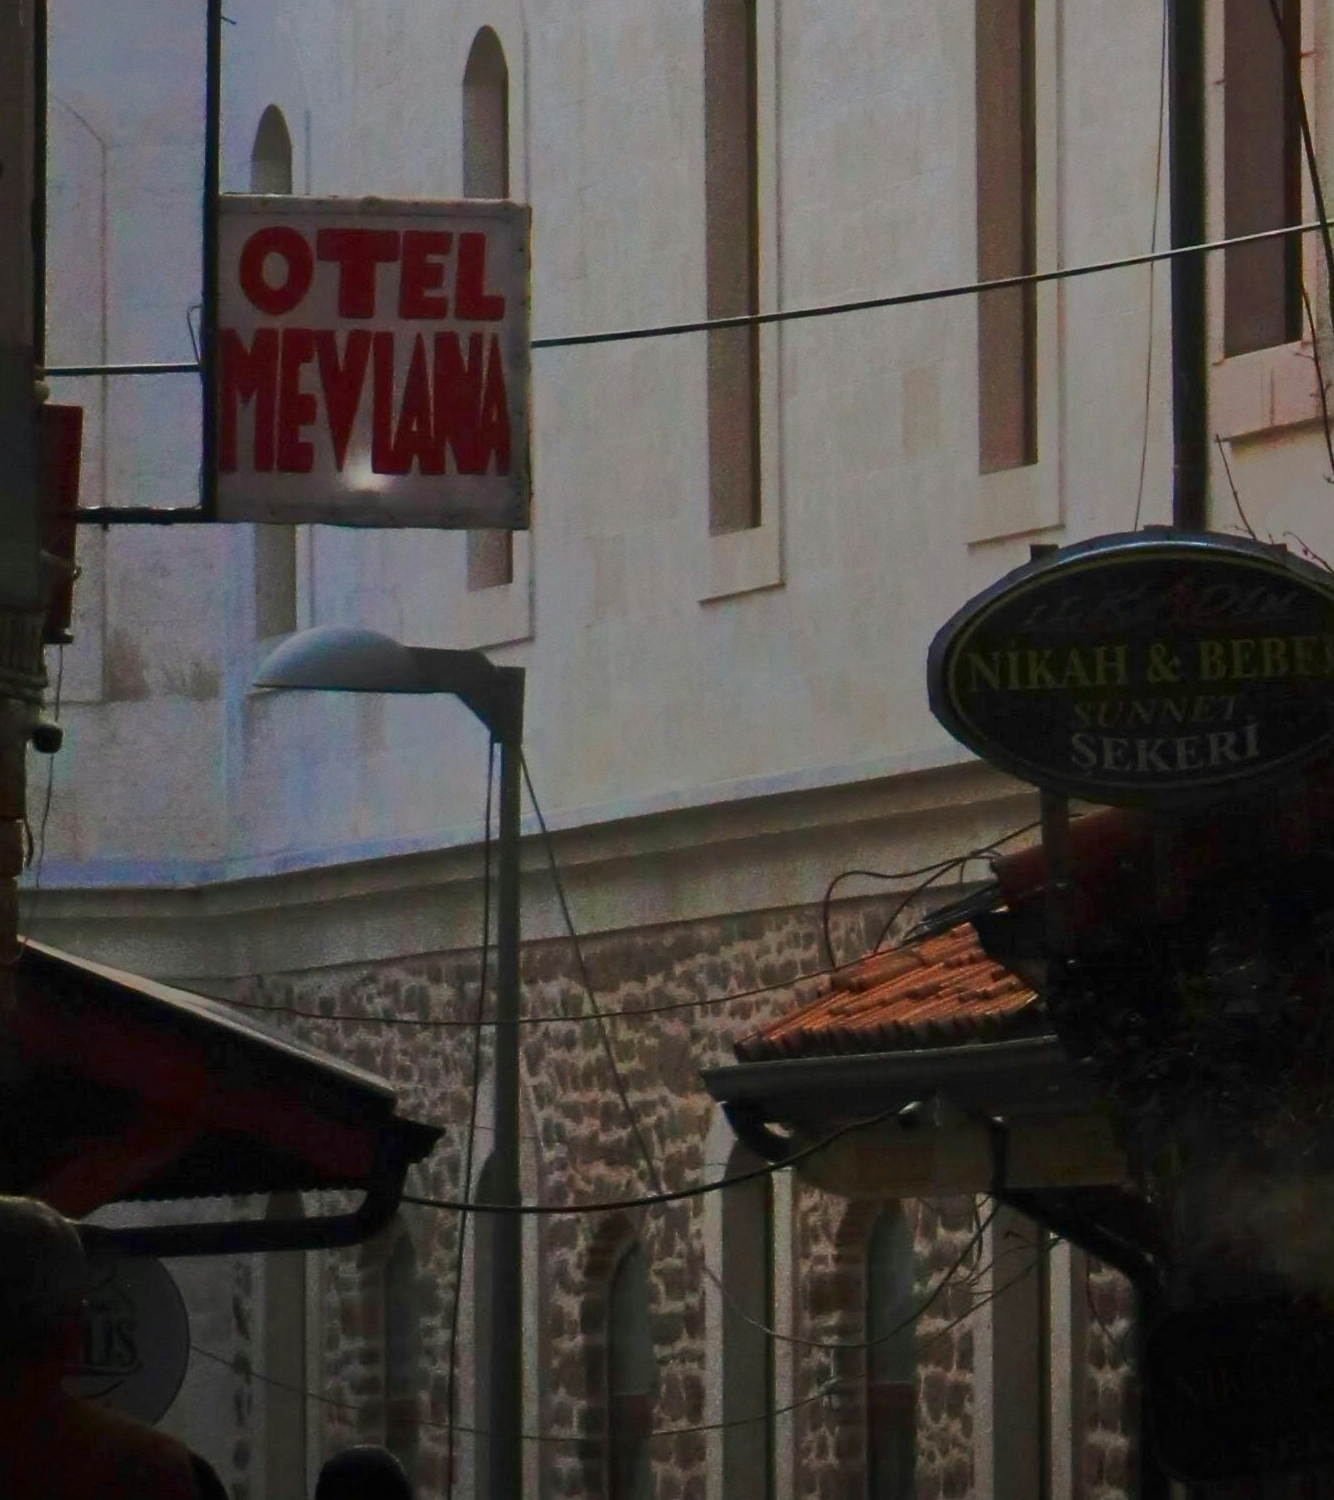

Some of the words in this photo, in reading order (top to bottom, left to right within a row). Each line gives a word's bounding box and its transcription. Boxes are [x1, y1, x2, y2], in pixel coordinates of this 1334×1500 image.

[238, 226, 505, 321] OTEL
[218, 327, 511, 476] MEVLANA
[966, 640, 1128, 692] NİKAH
[1145, 644, 1185, 683] &
[1070, 716, 1261, 777] ŞEKERİ
